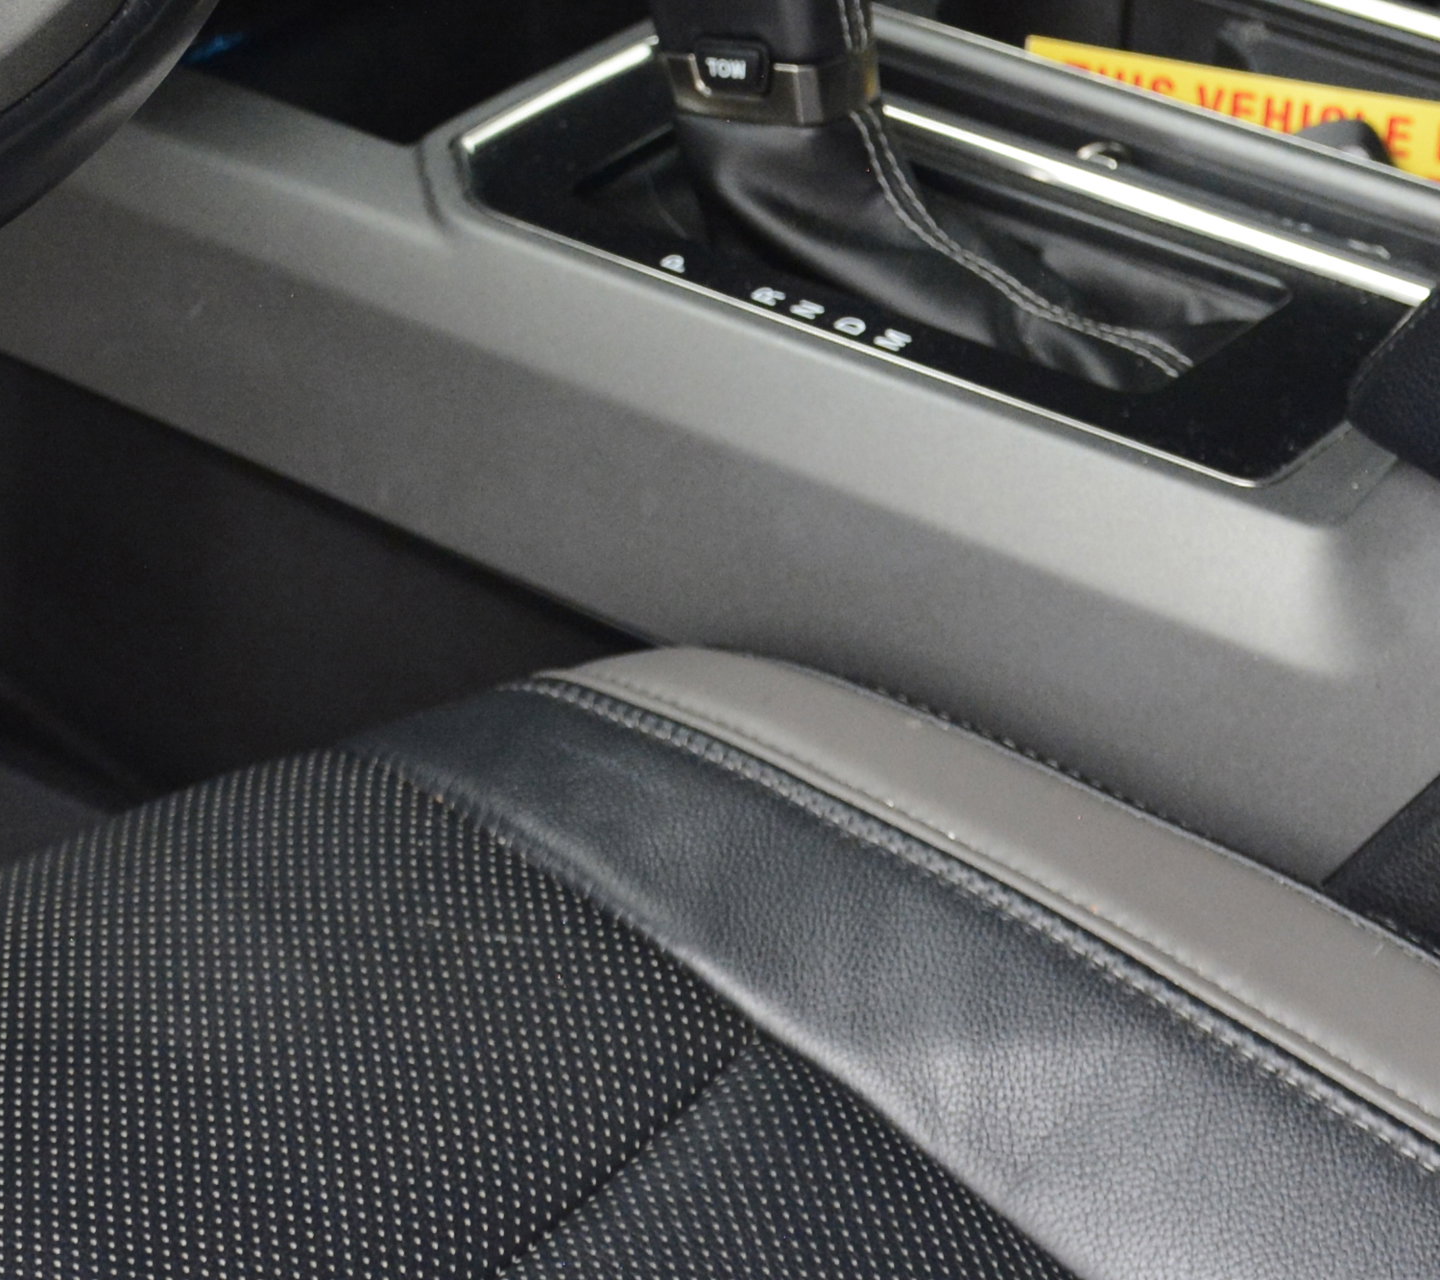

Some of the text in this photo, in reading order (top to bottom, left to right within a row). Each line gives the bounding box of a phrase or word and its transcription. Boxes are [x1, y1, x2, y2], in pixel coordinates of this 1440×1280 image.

[705, 56, 747, 80] TOW
[1196, 84, 1413, 158] VEHIE
[833, 316, 867, 336] D
